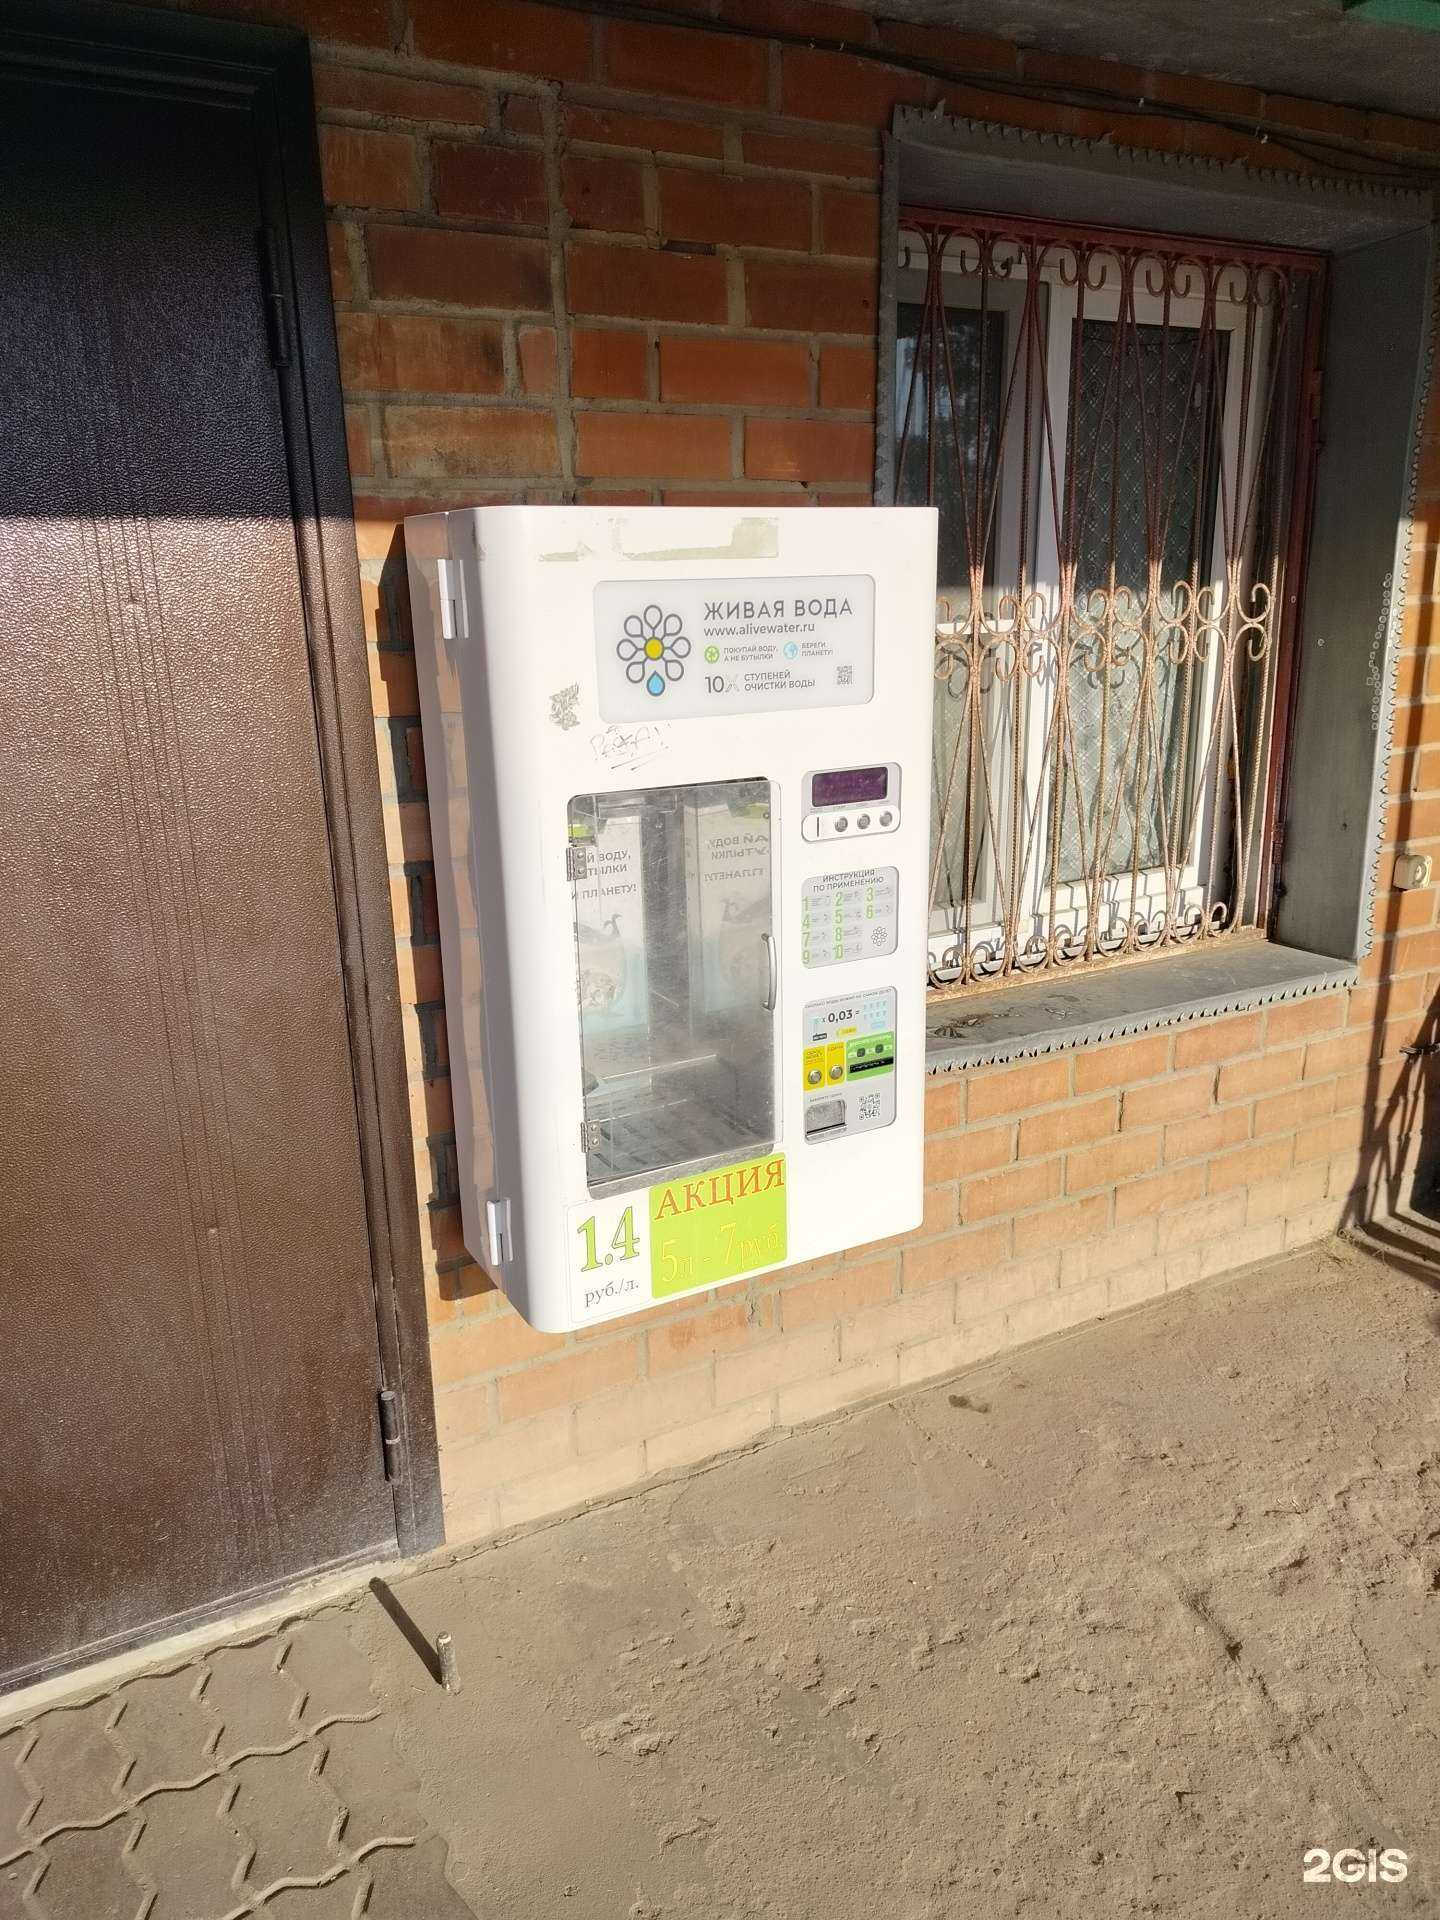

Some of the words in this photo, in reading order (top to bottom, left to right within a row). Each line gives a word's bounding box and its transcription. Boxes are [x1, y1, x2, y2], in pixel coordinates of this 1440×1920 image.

[704, 600, 785, 621] ЖИВАЯ
[795, 598, 853, 618] ВОДА
[703, 623, 815, 636] www.alivewater.ru
[724, 645, 757, 654] ПОКУПАЙ
[741, 654, 774, 662] БУТЫЛКИ
[744, 669, 791, 682] СТУПЕНЕЙ
[744, 681, 787, 692] ОЧИСТКИ
[788, 680, 816, 689] ВОДЫ
[586, 863, 628, 876] ТЫЛКИ
[823, 869, 875, 883] ИНСТРУКЦИЯ
[813, 884, 825, 893] ПО
[827, 876, 884, 890] ПРИМЕНЕНИЮ
[835, 891, 842, 907] 2
[866, 886, 874, 902] 3
[802, 896, 809, 912] 1
[866, 904, 874, 920] 6
[802, 914, 810, 929] 4
[835, 909, 842, 924] 5
[802, 931, 810, 948] 7
[835, 926, 842, 942] 8
[802, 949, 810, 965] 9
[827, 1009, 853, 1023] 0,03
[654, 1158, 785, 1221] АКЦИЯ
[577, 1205, 640, 1272] 1.4
[584, 1278, 640, 1308] руб./л.
